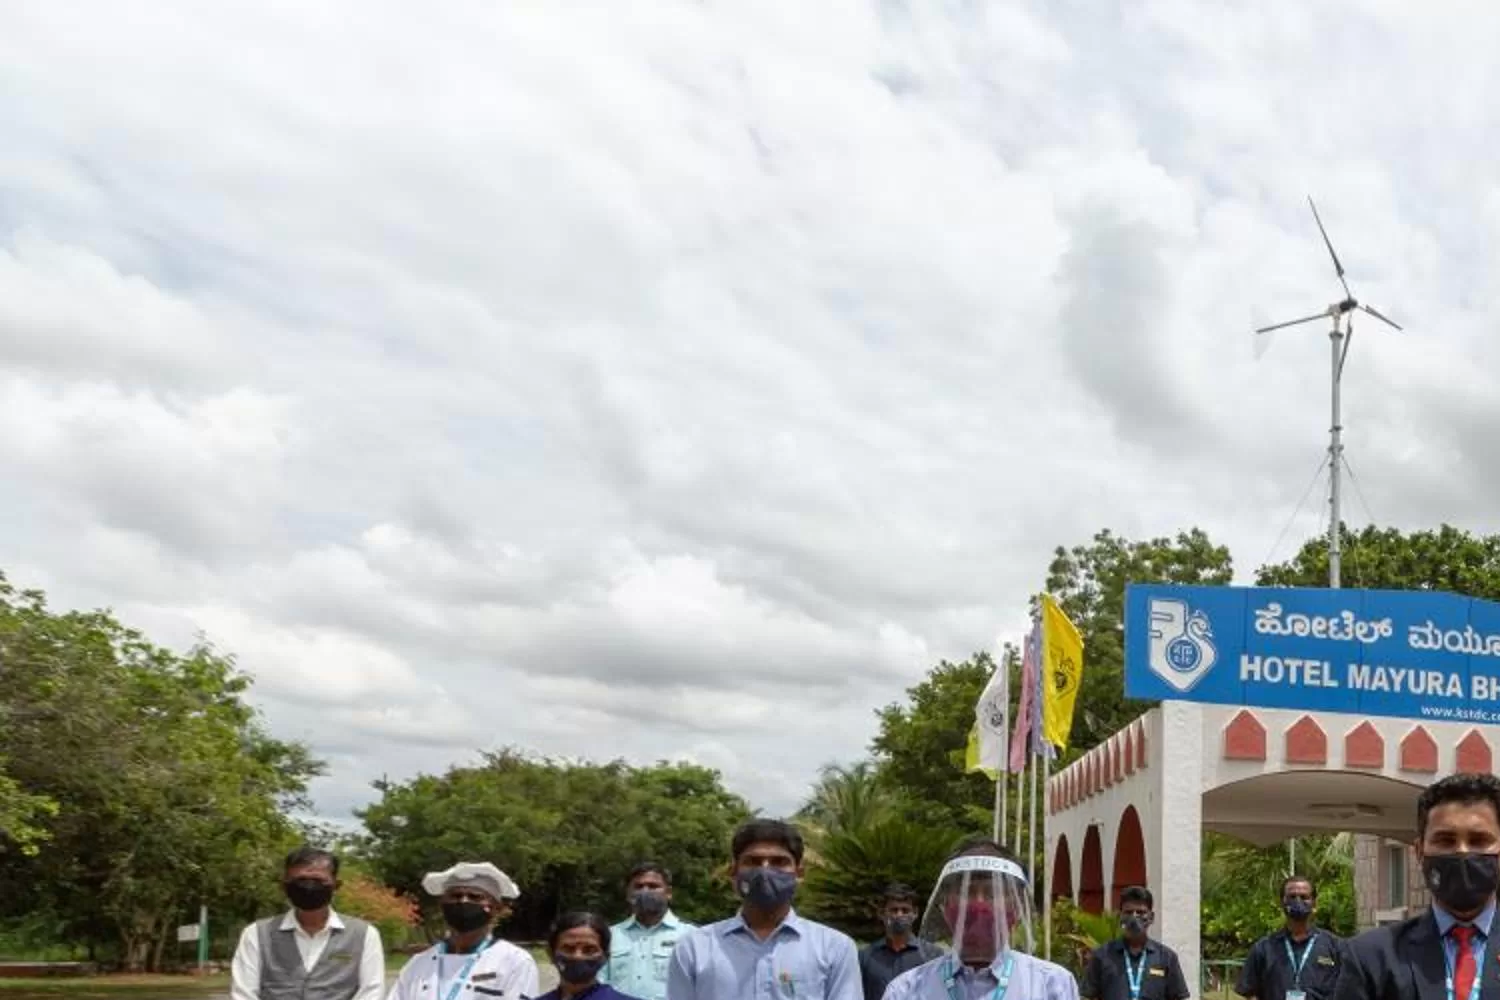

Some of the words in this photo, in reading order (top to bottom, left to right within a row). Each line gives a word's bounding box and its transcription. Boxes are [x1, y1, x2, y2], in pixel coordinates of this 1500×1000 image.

[1254, 602, 1393, 643] ಹೋಟೆಲ್
[1240, 654, 1338, 688] HOTEL
[1347, 663, 1464, 699] MAYURA
